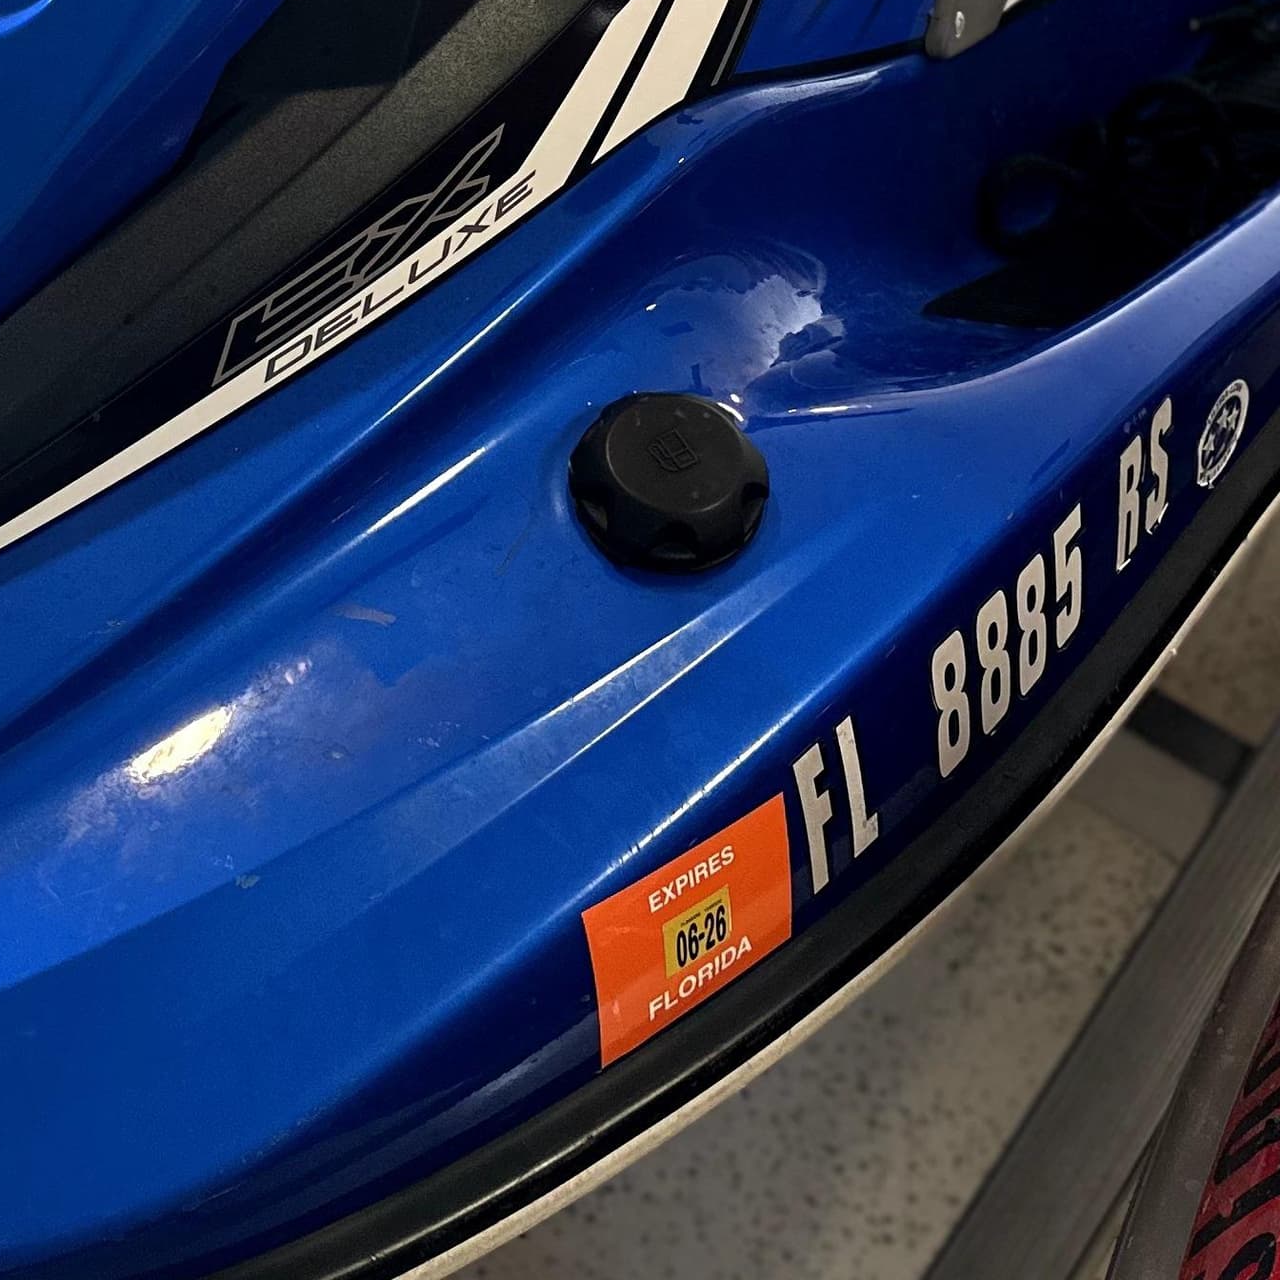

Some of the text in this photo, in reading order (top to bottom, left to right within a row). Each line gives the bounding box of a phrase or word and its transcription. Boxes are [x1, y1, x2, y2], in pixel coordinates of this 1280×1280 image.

[263, 169, 537, 384] DELUXE
[793, 396, 1173, 895] FL 8885 RS
[648, 845, 735, 913] EXPIRES
[648, 935, 753, 1022] FLORIDA
[676, 904, 728, 968] 06-26
